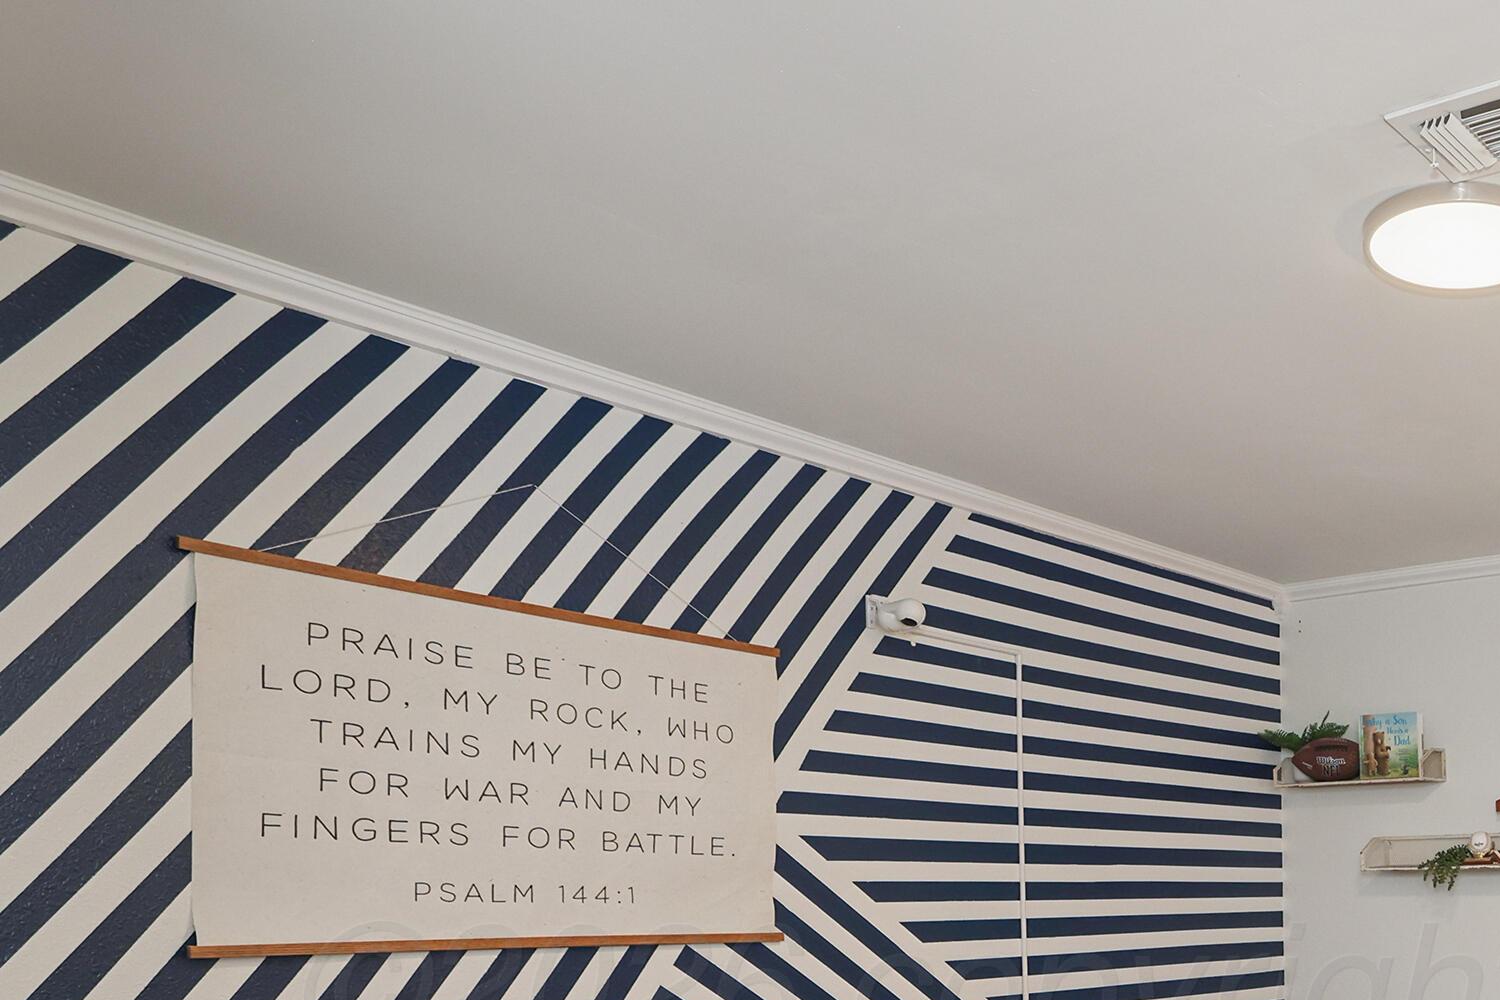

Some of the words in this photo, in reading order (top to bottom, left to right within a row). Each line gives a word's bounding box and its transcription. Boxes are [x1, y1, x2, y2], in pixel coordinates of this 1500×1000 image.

[308, 621, 474, 670] PRAISE
[506, 653, 552, 681] BE
[579, 664, 622, 690] TO
[648, 675, 709, 704] THE
[261, 664, 410, 709] LORD,
[444, 688, 498, 716] MY
[530, 699, 642, 737] ROCK,
[668, 717, 734, 745] WHO
[310, 719, 481, 759] TRAINS
[513, 740, 562, 765] MY
[590, 748, 707, 780] HANDS
[320, 768, 409, 799] FOR
[445, 778, 529, 806] WAR
[559, 787, 631, 813] AND
[659, 795, 702, 817] MY
[261, 813, 469, 847] FINGERS
[503, 826, 576, 851] FOR
[603, 831, 736, 857] BATTLE.
[415, 880, 534, 904] PSALM
[559, 885, 635, 904] 144:1
